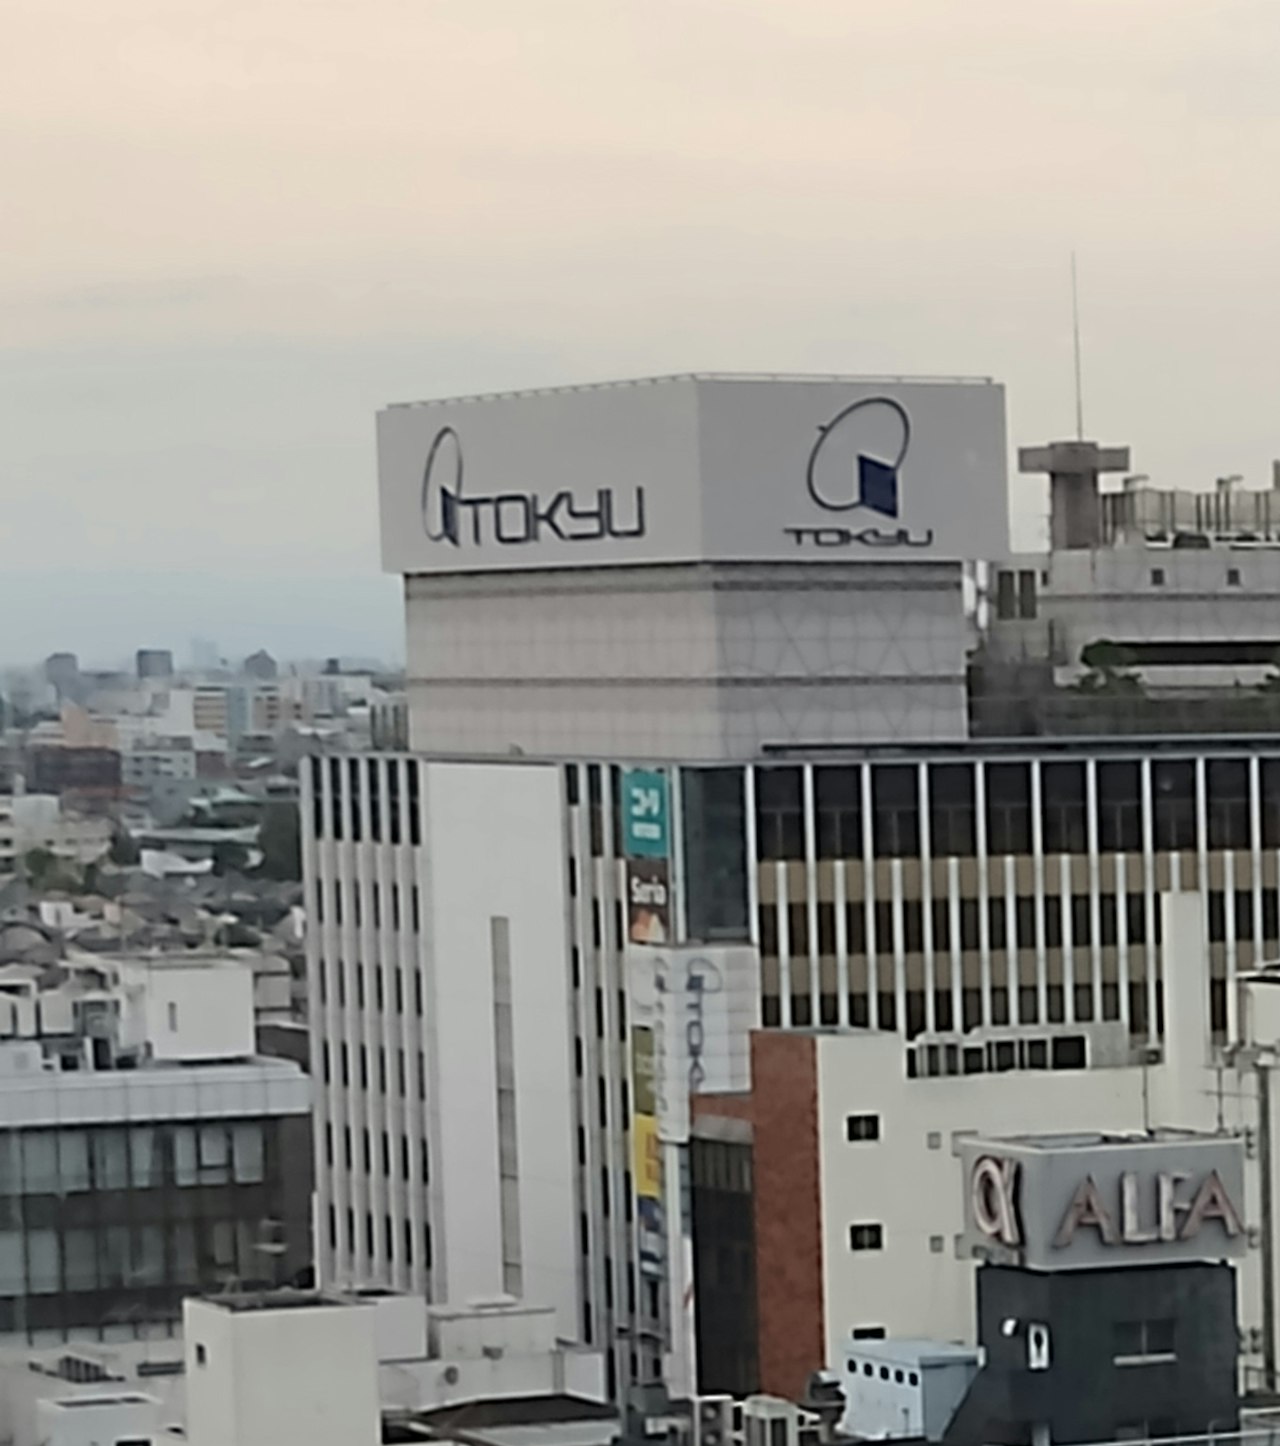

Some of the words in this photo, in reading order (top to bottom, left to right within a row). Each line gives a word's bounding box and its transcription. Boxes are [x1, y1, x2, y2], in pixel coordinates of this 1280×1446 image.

[459, 486, 645, 547] TOKYU
[783, 526, 934, 547] TOKYU
[1052, 1167, 1248, 1249] ALFA
